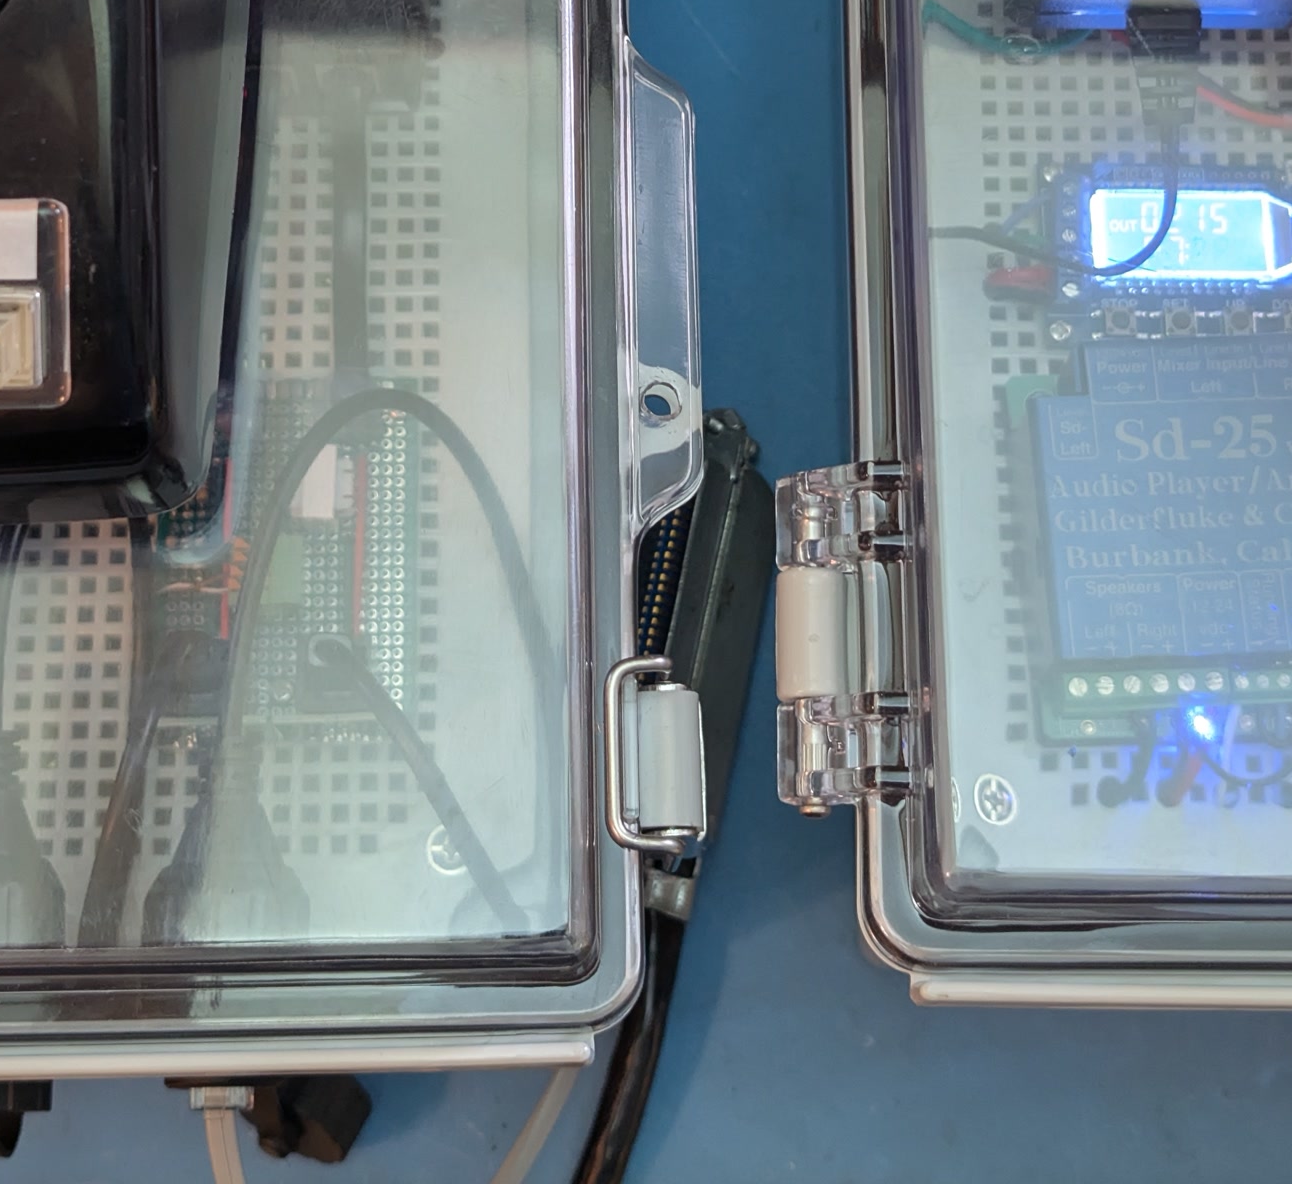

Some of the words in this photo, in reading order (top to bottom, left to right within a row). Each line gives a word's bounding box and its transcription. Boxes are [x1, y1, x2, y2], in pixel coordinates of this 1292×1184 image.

[1108, 218, 1138, 234] OUT
[1096, 361, 1148, 375] Power
[1157, 359, 1201, 373] Mixer
[1190, 379, 1223, 394] Left
[1114, 413, 1277, 463] Sd-25
[1060, 439, 1093, 456] Left
[1049, 471, 1138, 499] Audio
[1054, 505, 1234, 533] Gilderfluke
[1243, 503, 1265, 526] &
[1064, 540, 1228, 569] Burbank,
[1085, 580, 1162, 598] Speakers
[1182, 576, 1238, 592] Power
